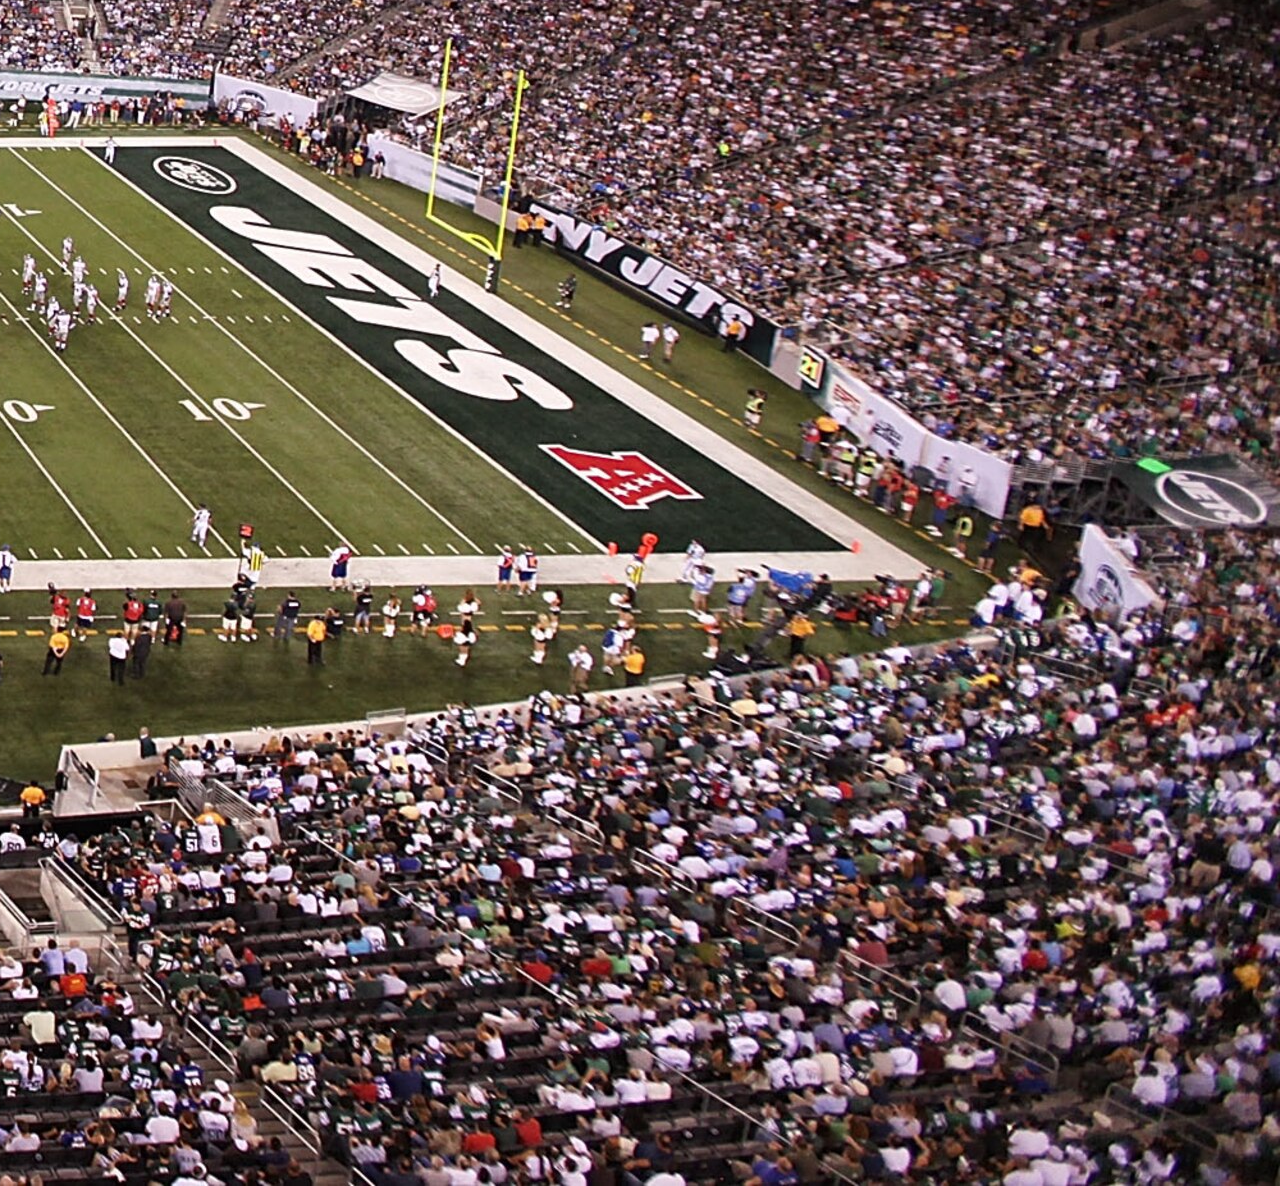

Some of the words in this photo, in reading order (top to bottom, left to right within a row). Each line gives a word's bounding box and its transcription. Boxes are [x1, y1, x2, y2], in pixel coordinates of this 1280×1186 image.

[50, 82, 106, 97] JETS
[541, 213, 626, 263] NY
[619, 255, 755, 341] JETS
[210, 206, 575, 410] JETS
[800, 354, 820, 381] 21
[179, 398, 251, 420] 10
[186, 838, 198, 852] 51
[211, 835, 218, 848] 6
